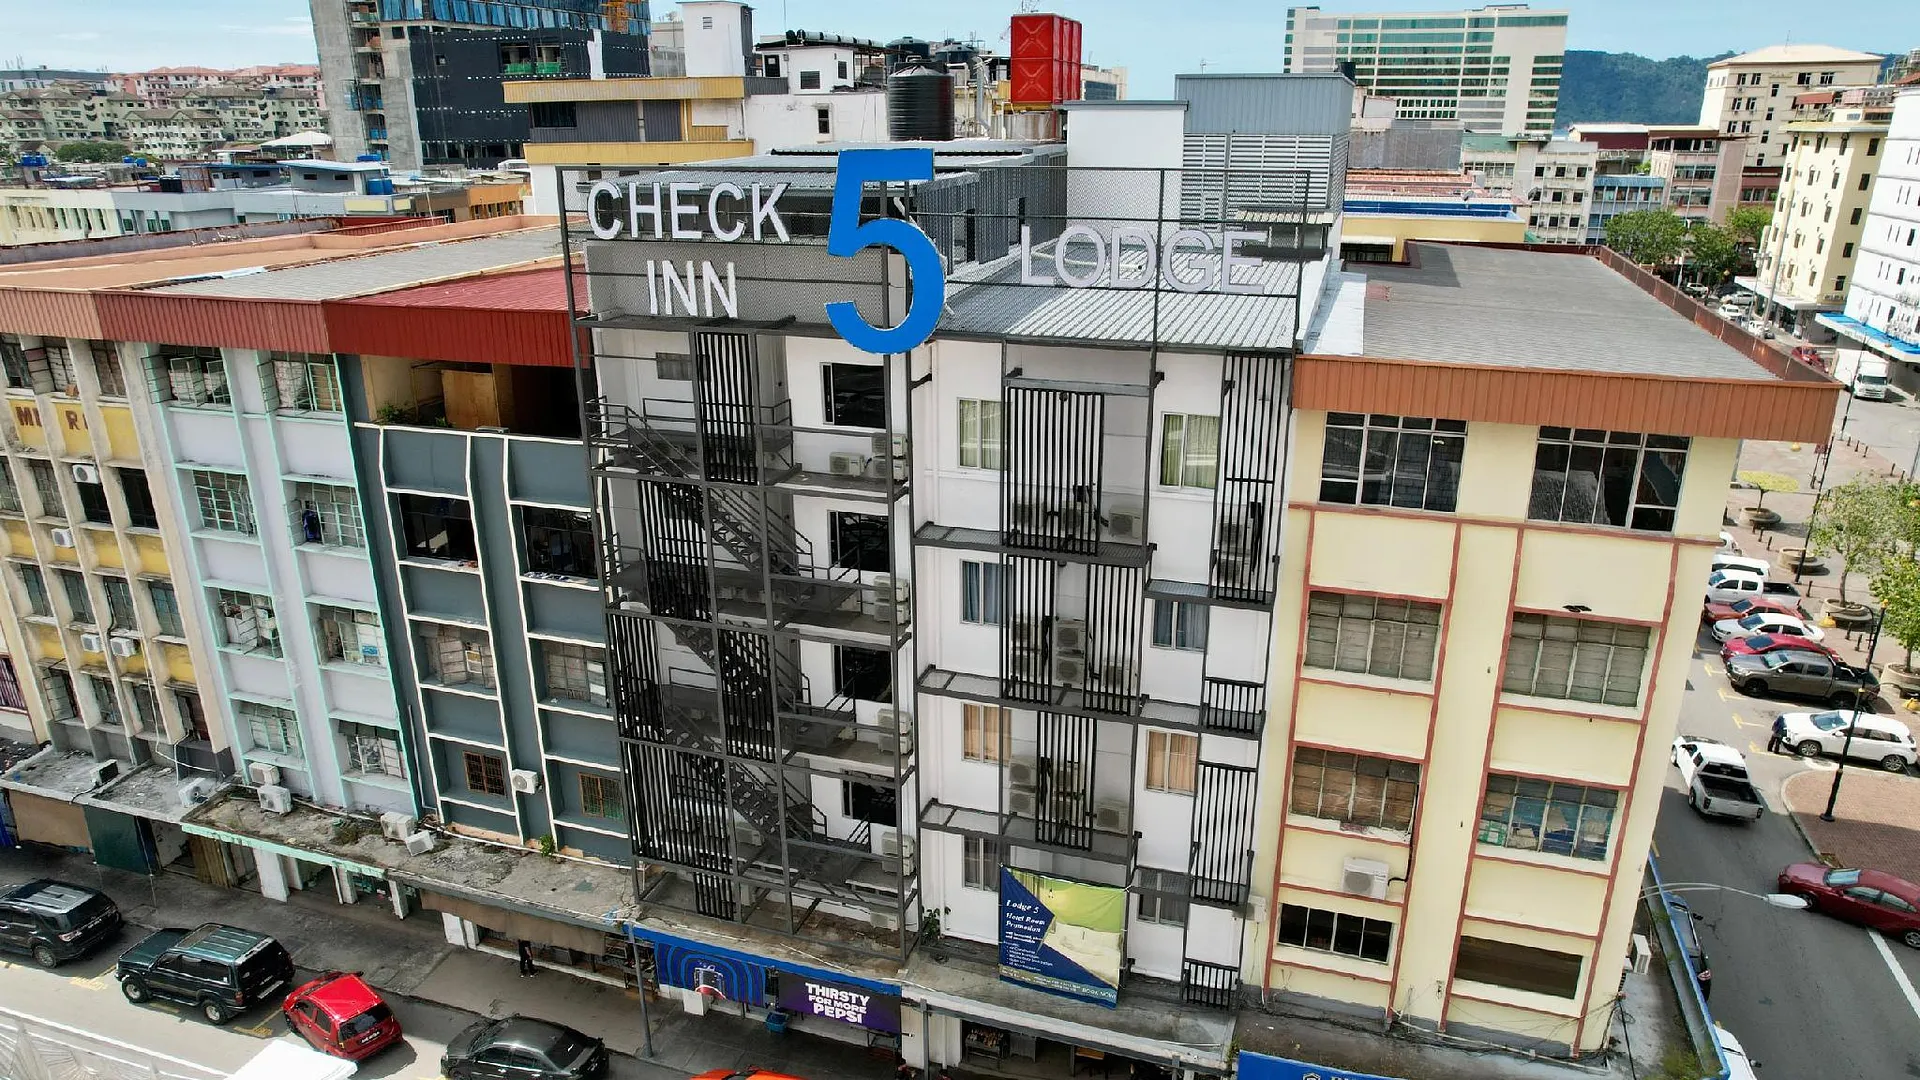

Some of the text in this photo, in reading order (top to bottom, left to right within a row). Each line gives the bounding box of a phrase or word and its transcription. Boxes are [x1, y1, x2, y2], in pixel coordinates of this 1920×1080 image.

[588, 181, 791, 243] CHECK
[825, 148, 946, 355] 5
[1021, 224, 1268, 294] LODGE
[647, 260, 738, 318] INN
[805, 982, 870, 1006] THIRSTY
[808, 995, 867, 1014] FOR MORE
[813, 1003, 862, 1023] PEPSI
